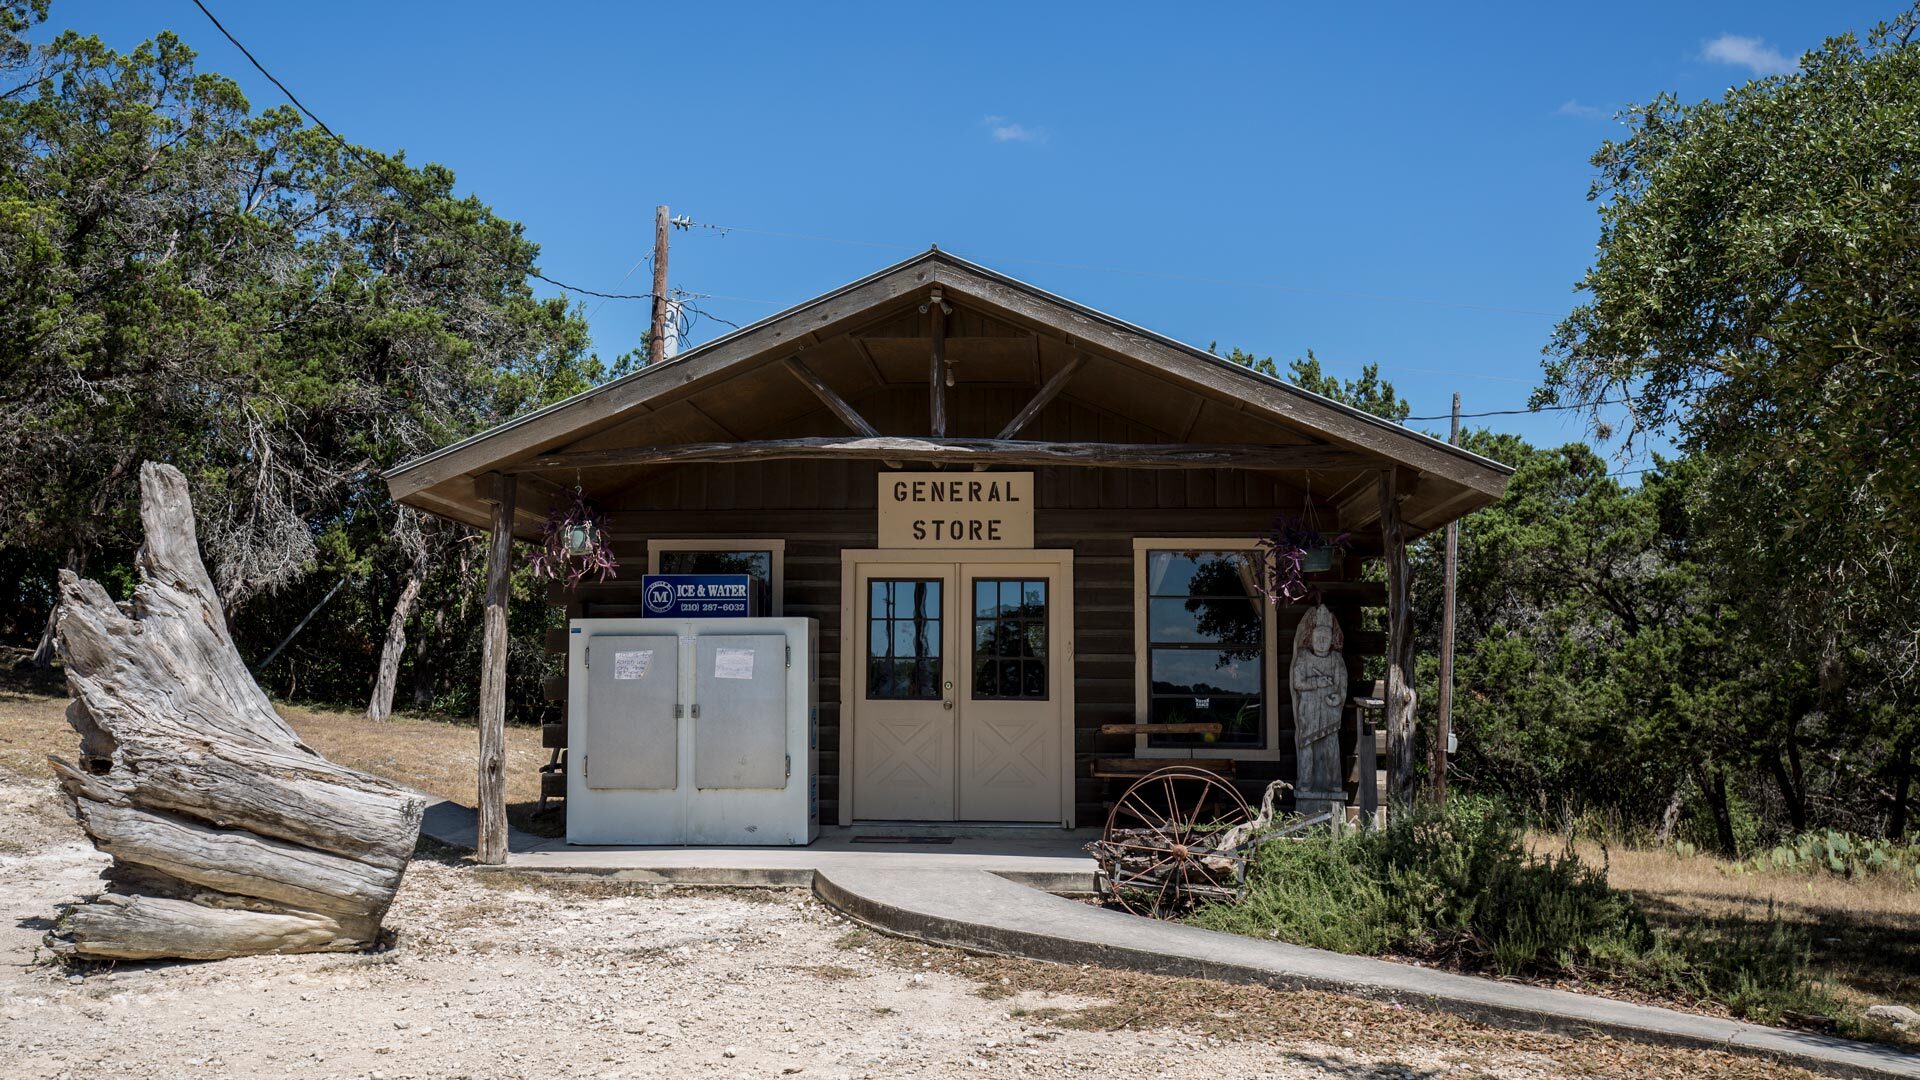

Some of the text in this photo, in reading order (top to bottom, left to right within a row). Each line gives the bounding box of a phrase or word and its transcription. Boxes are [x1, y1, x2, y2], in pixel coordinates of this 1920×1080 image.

[893, 481, 1020, 502] GENERAL
[912, 519, 1002, 541] STORE
[652, 591, 669, 603] M
[676, 584, 696, 597] ICE
[697, 584, 706, 597] &
[707, 584, 747, 597] WATER
[680, 602, 700, 612] (210)
[702, 603, 745, 611] 287-6032
